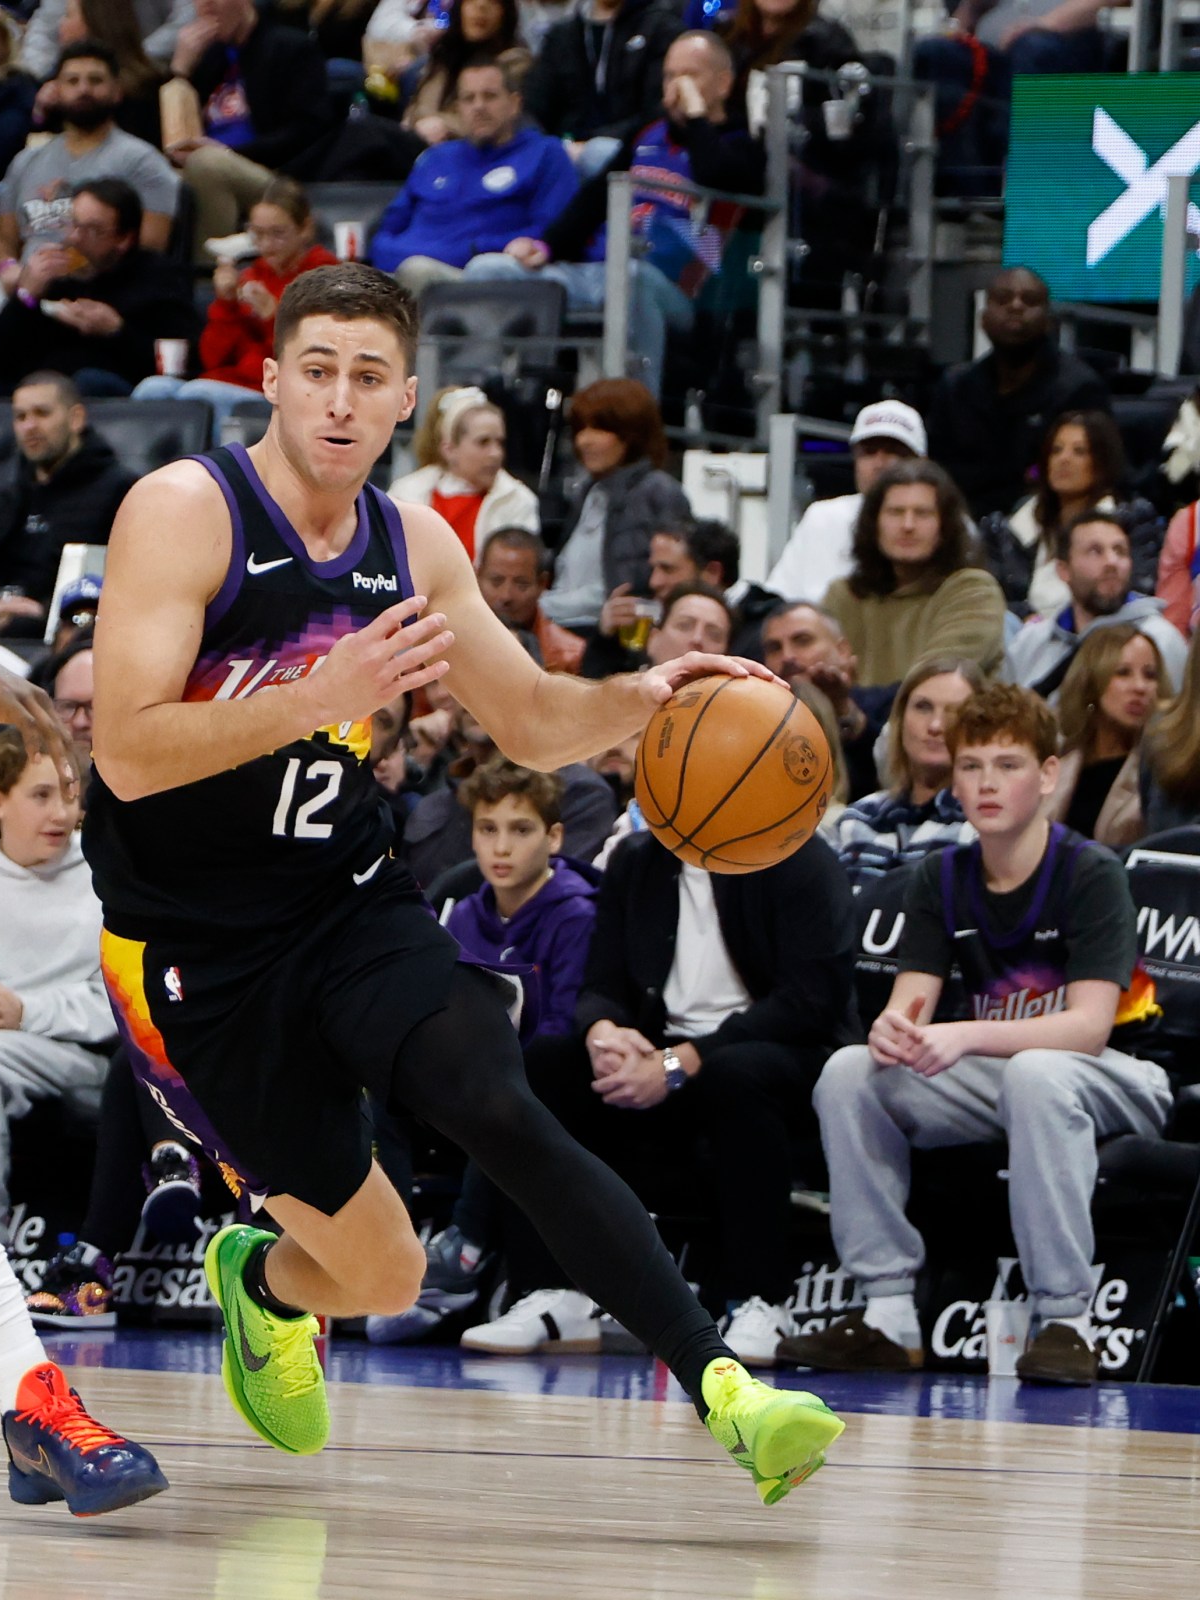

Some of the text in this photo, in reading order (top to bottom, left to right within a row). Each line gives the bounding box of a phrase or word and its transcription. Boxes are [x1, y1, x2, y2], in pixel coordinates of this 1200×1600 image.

[352, 571, 398, 594] PayPal
[268, 664, 307, 682] THE
[272, 758, 344, 839] 12
